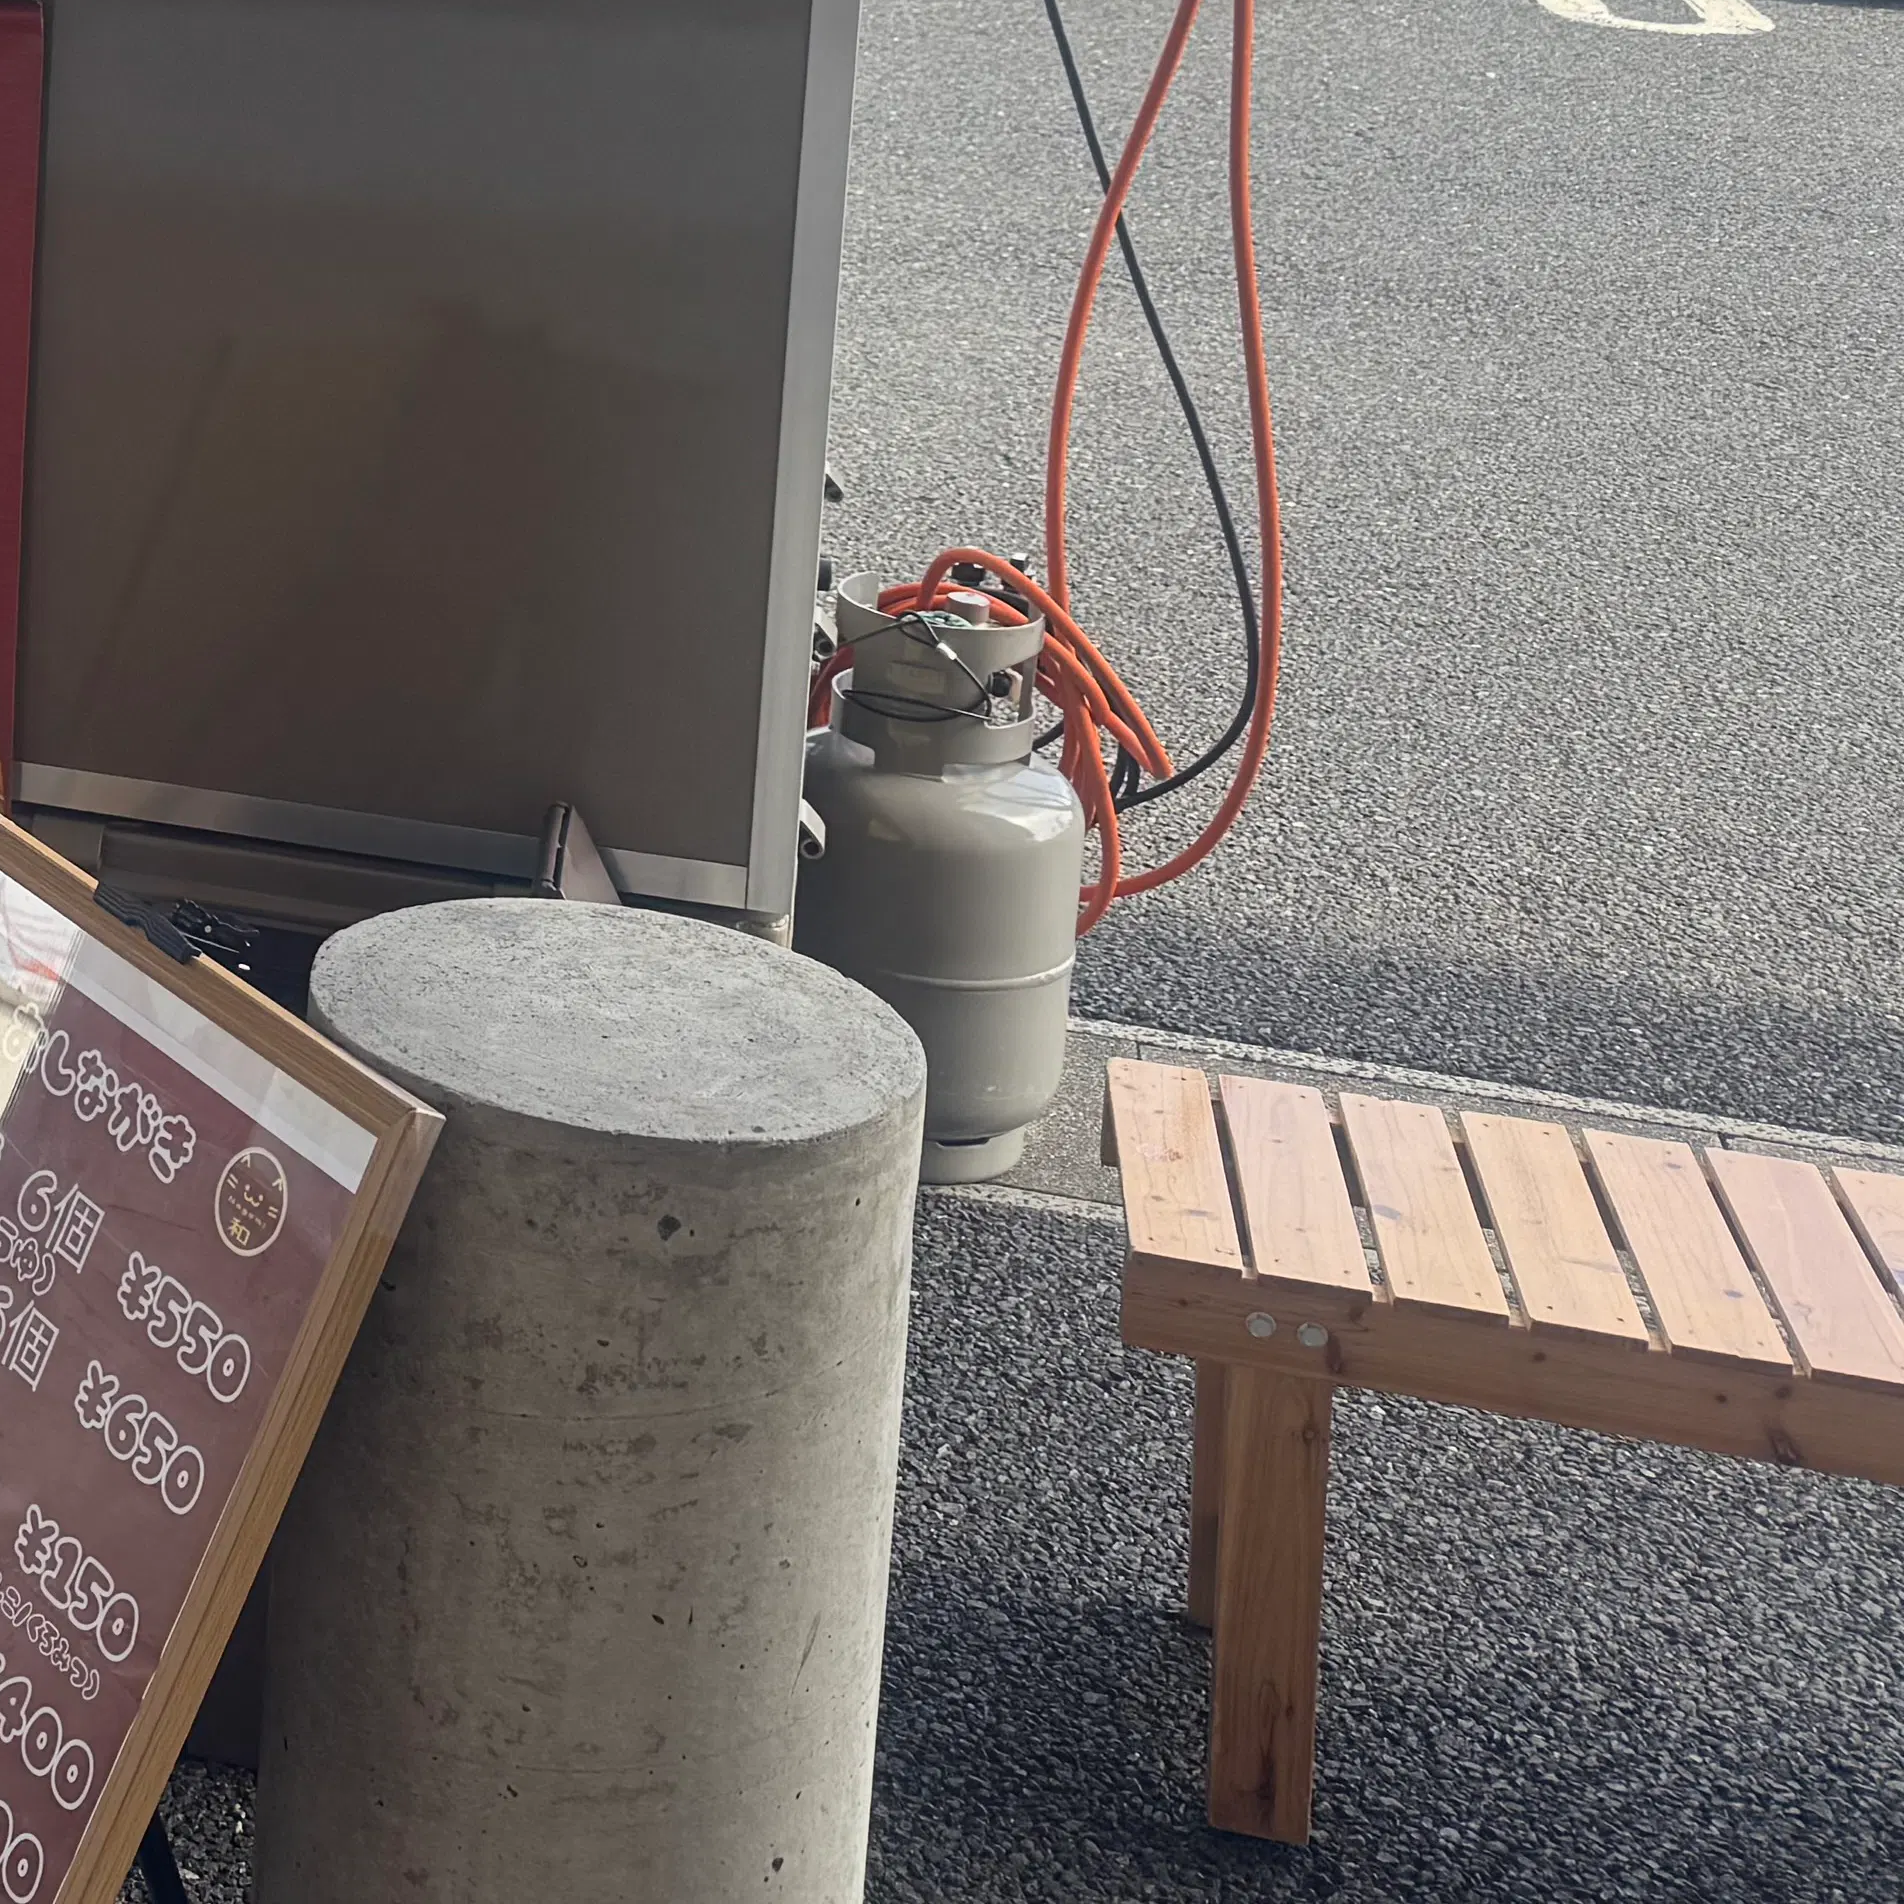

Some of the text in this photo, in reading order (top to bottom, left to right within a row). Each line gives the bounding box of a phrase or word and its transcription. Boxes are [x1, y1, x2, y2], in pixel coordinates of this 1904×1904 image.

[2, 1002, 196, 1184] おしながき
[17, 1169, 105, 1274] 6個
[117, 1251, 251, 1403] ¥550
[74, 1359, 205, 1515] ¥650
[14, 1503, 141, 1662] ¥150
